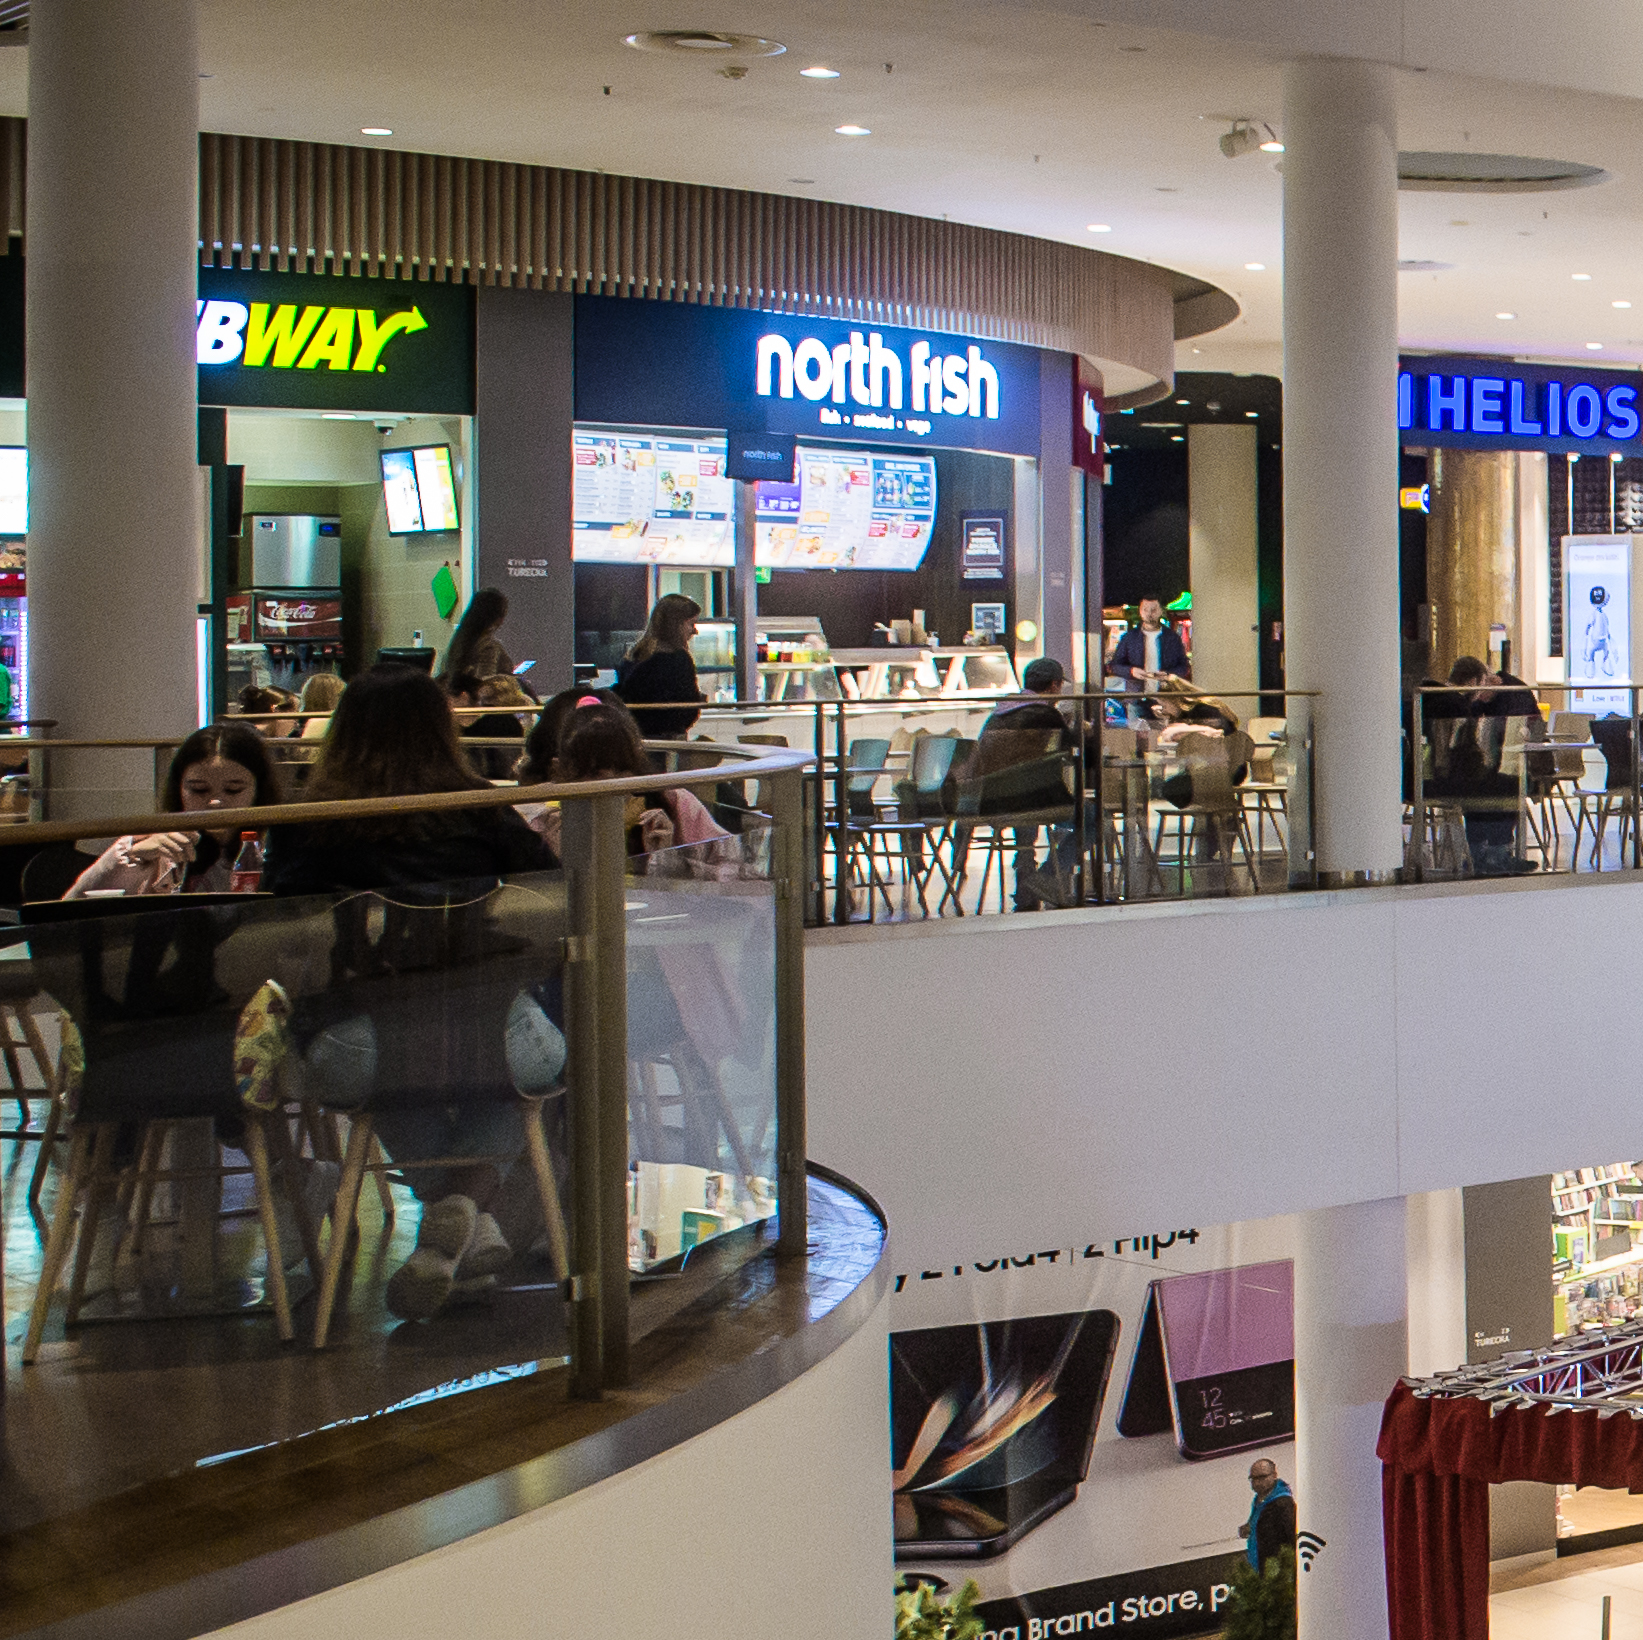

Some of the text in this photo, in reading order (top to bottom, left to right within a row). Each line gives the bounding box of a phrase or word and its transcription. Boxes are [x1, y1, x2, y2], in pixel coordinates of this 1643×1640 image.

[197, 300, 428, 373] BWAY
[756, 331, 903, 410] north
[910, 340, 1000, 420] fish
[1428, 372, 1642, 441] HELIOS
[1199, 1386, 1223, 1409] 12
[1201, 1407, 1228, 1430] 45
[1121, 1588, 1205, 1633] Store,
